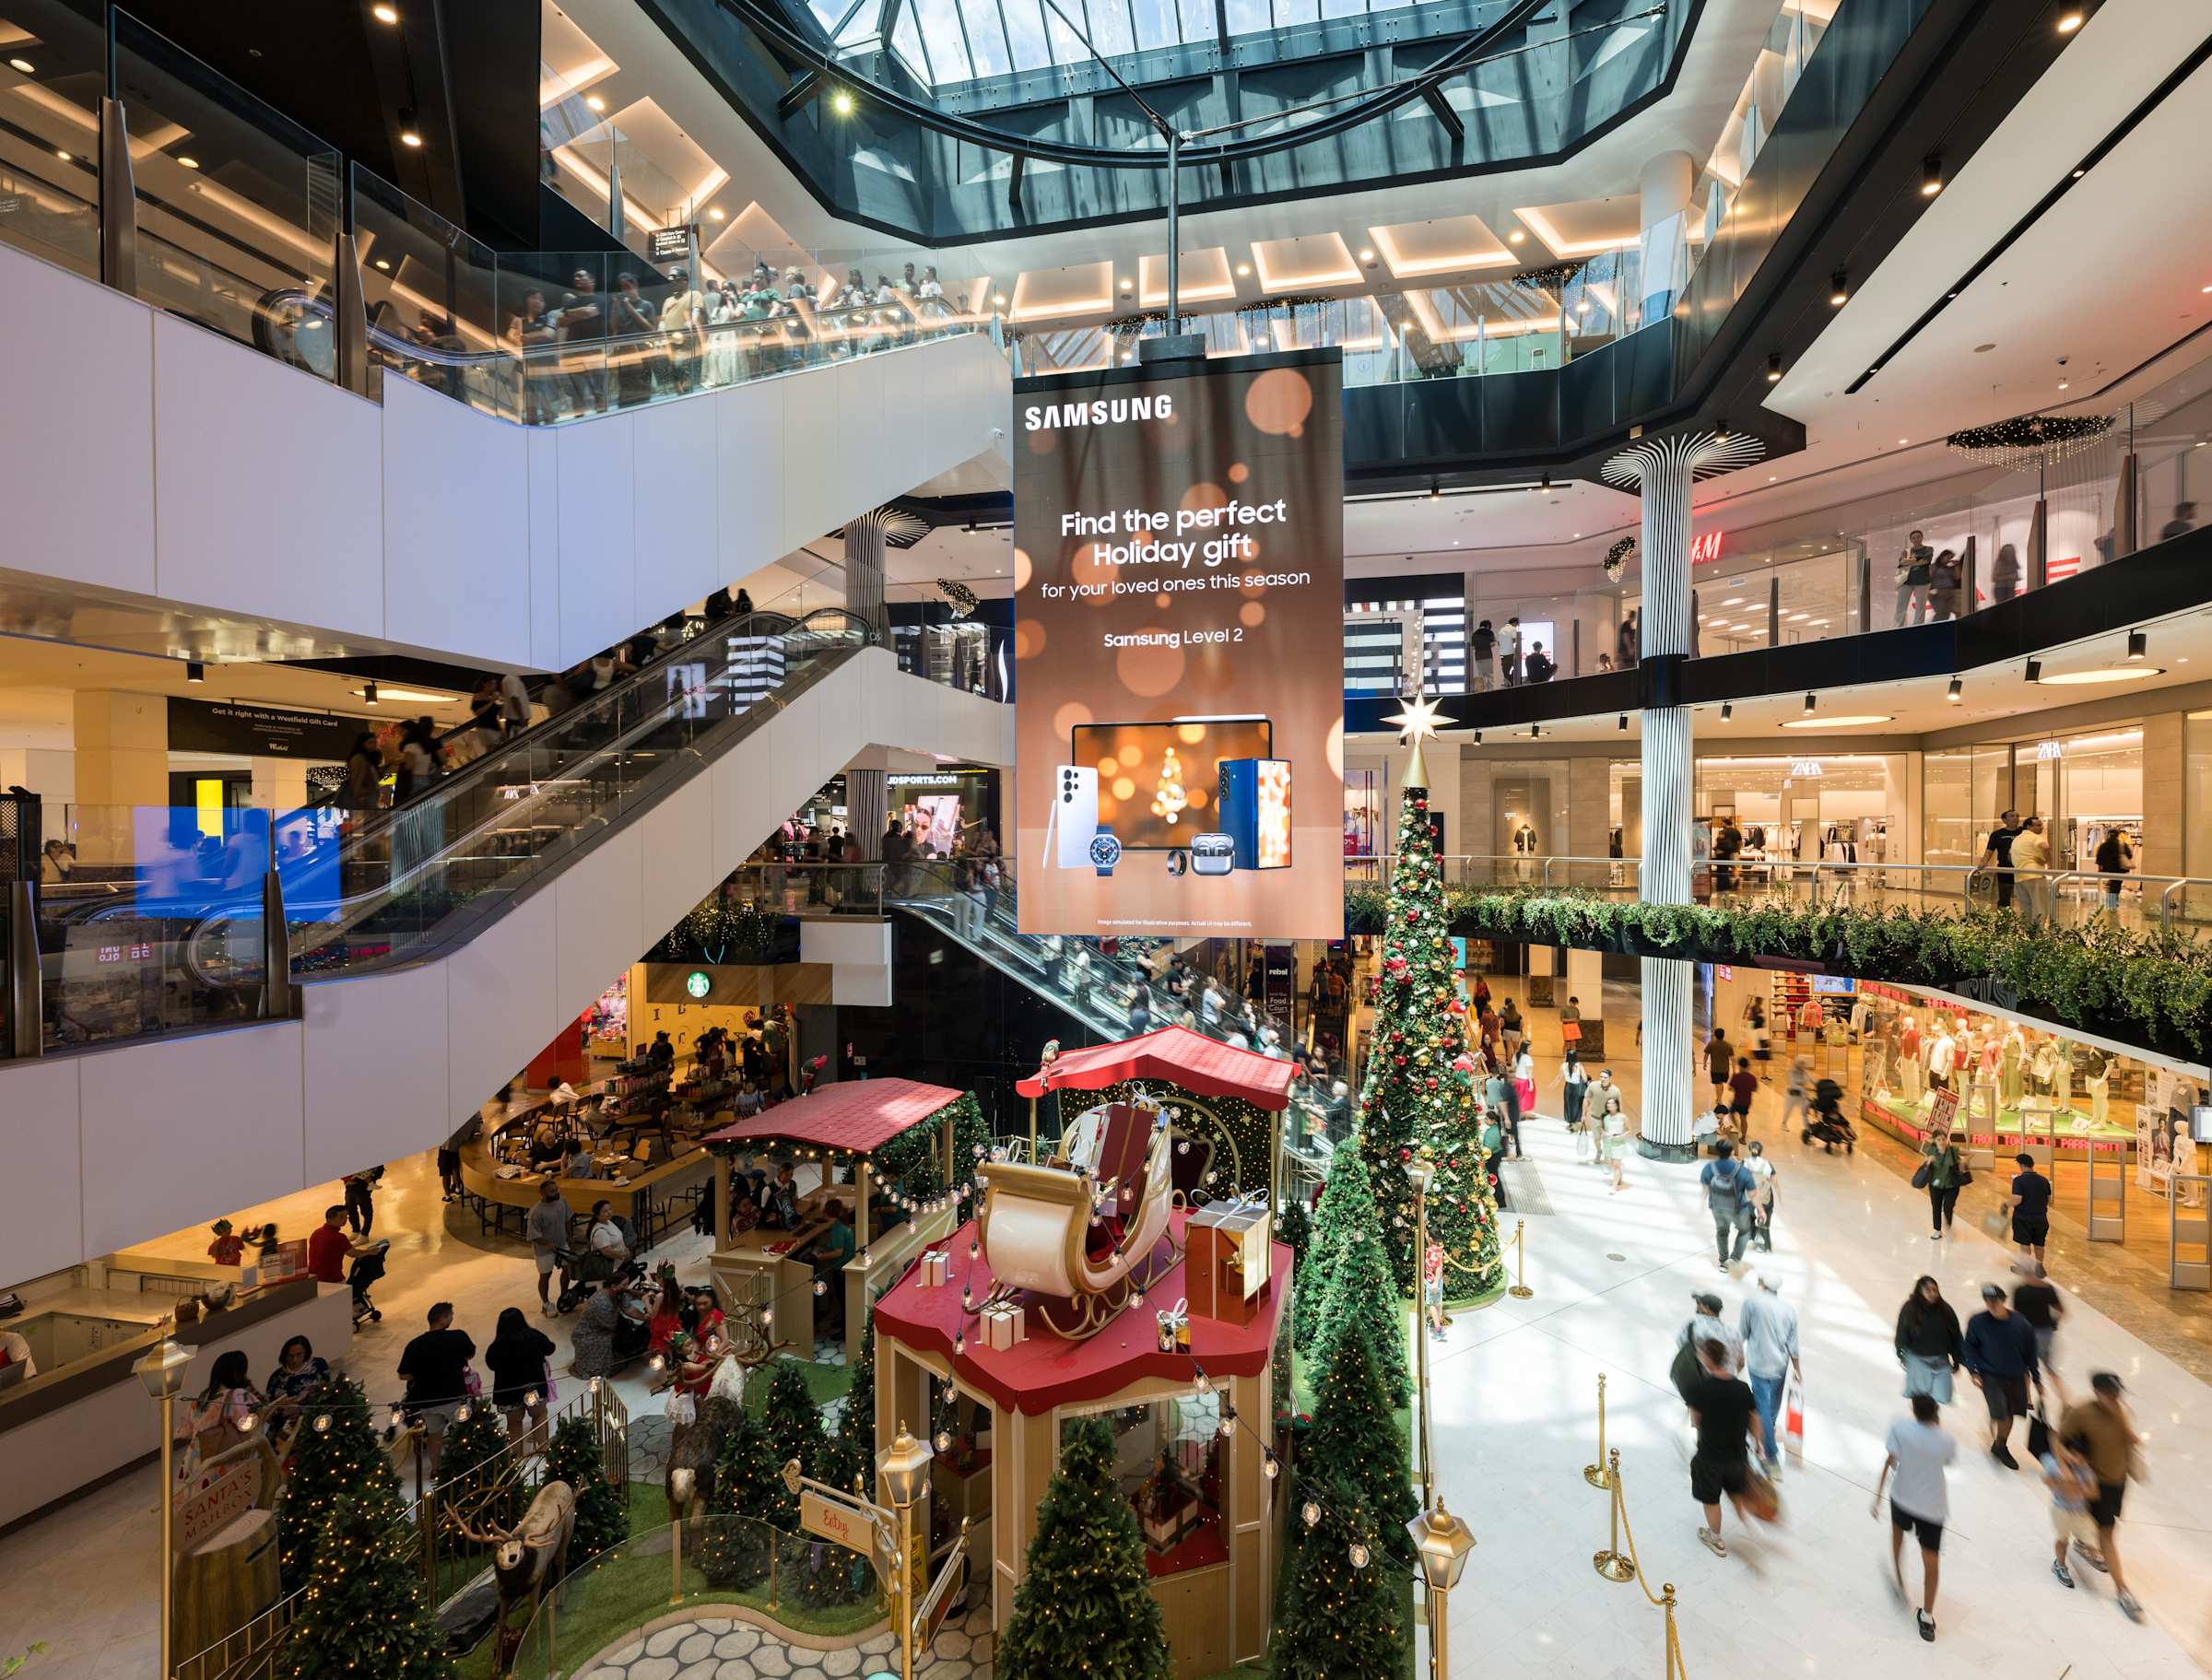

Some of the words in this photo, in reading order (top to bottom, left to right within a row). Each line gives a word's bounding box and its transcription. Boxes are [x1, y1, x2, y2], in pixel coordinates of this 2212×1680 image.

[1025, 394, 1172, 431] SAMSUNG
[1061, 511, 1116, 536] Find
[1122, 509, 1170, 532] the
[1176, 499, 1287, 537] perfect
[1093, 539, 1197, 568] Holiday
[1204, 532, 1253, 568] gift
[1041, 582, 1065, 598] for
[1069, 584, 1108, 601] your
[1111, 579, 1159, 595] loved
[1162, 579, 1206, 593] ones
[1209, 575, 1241, 590] this
[1244, 573, 1311, 587] season
[1103, 632, 1181, 650] Samsung
[1184, 629, 1230, 644] Level
[1233, 629, 1243, 642] 2
[235, 711, 253, 720] right
[253, 711, 270, 721] with
[276, 715, 308, 724] Westfield
[309, 718, 322, 726] Gift
[887, 775, 958, 785] JDSPORTS.COM
[1791, 762, 1822, 776] ZARA
[184, 1469, 253, 1526] SANTA'S
[823, 1509, 849, 1542] Entry
